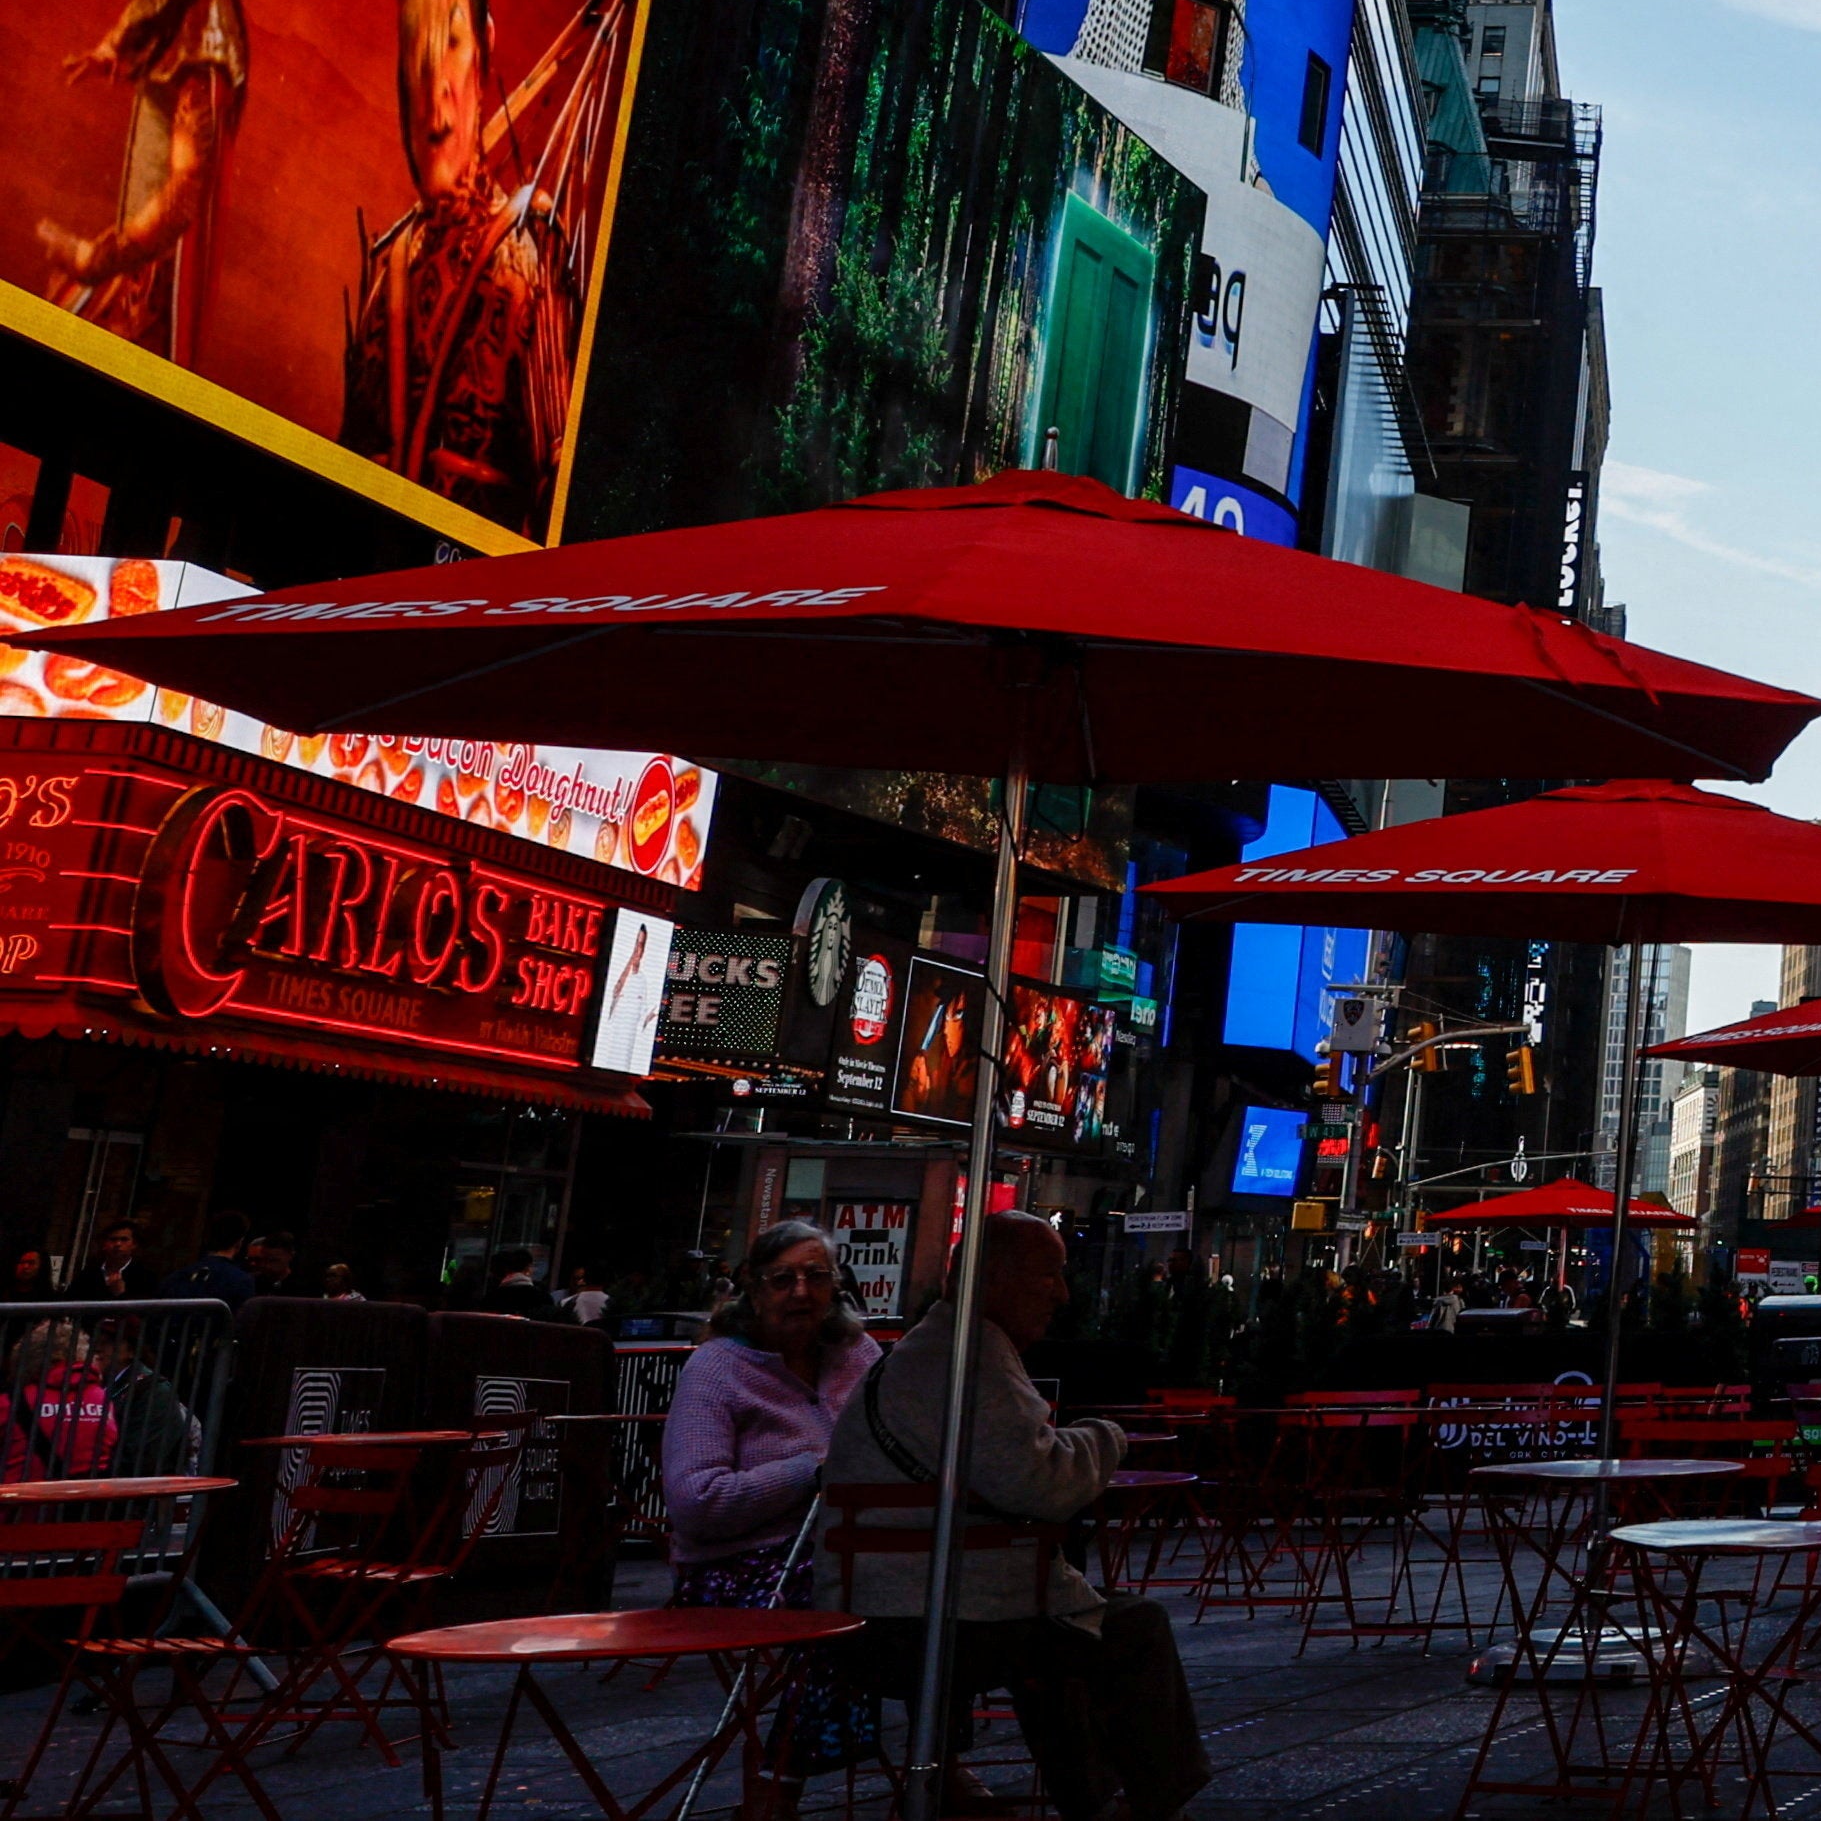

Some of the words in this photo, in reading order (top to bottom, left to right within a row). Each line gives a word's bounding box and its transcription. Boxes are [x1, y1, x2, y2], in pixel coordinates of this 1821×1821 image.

[200, 599, 471, 623] TIMES
[484, 585, 886, 616] SQUARE
[500, 744, 634, 825] Doughnut!
[7, 842, 50, 868] 1910
[1233, 868, 1400, 883] TIMES
[1405, 869, 1638, 884] SQUARE
[525, 894, 600, 957] BAKE
[512, 956, 591, 1015] SHOP
[267, 970, 333, 1012] TIMES
[338, 983, 422, 1029] SQUARE
[755, 1086, 798, 1096] SEPTEMBER
[837, 1070, 872, 1089] September
[874, 1077, 883, 1091] 12
[838, 1205, 906, 1229] ATM
[1566, 1206, 1615, 1215] TIMES
[838, 1242, 900, 1266] Drink
[859, 1275, 896, 1302] ndy
[1470, 1431, 1506, 1447] DEL
[1516, 1431, 1567, 1446] VINO
